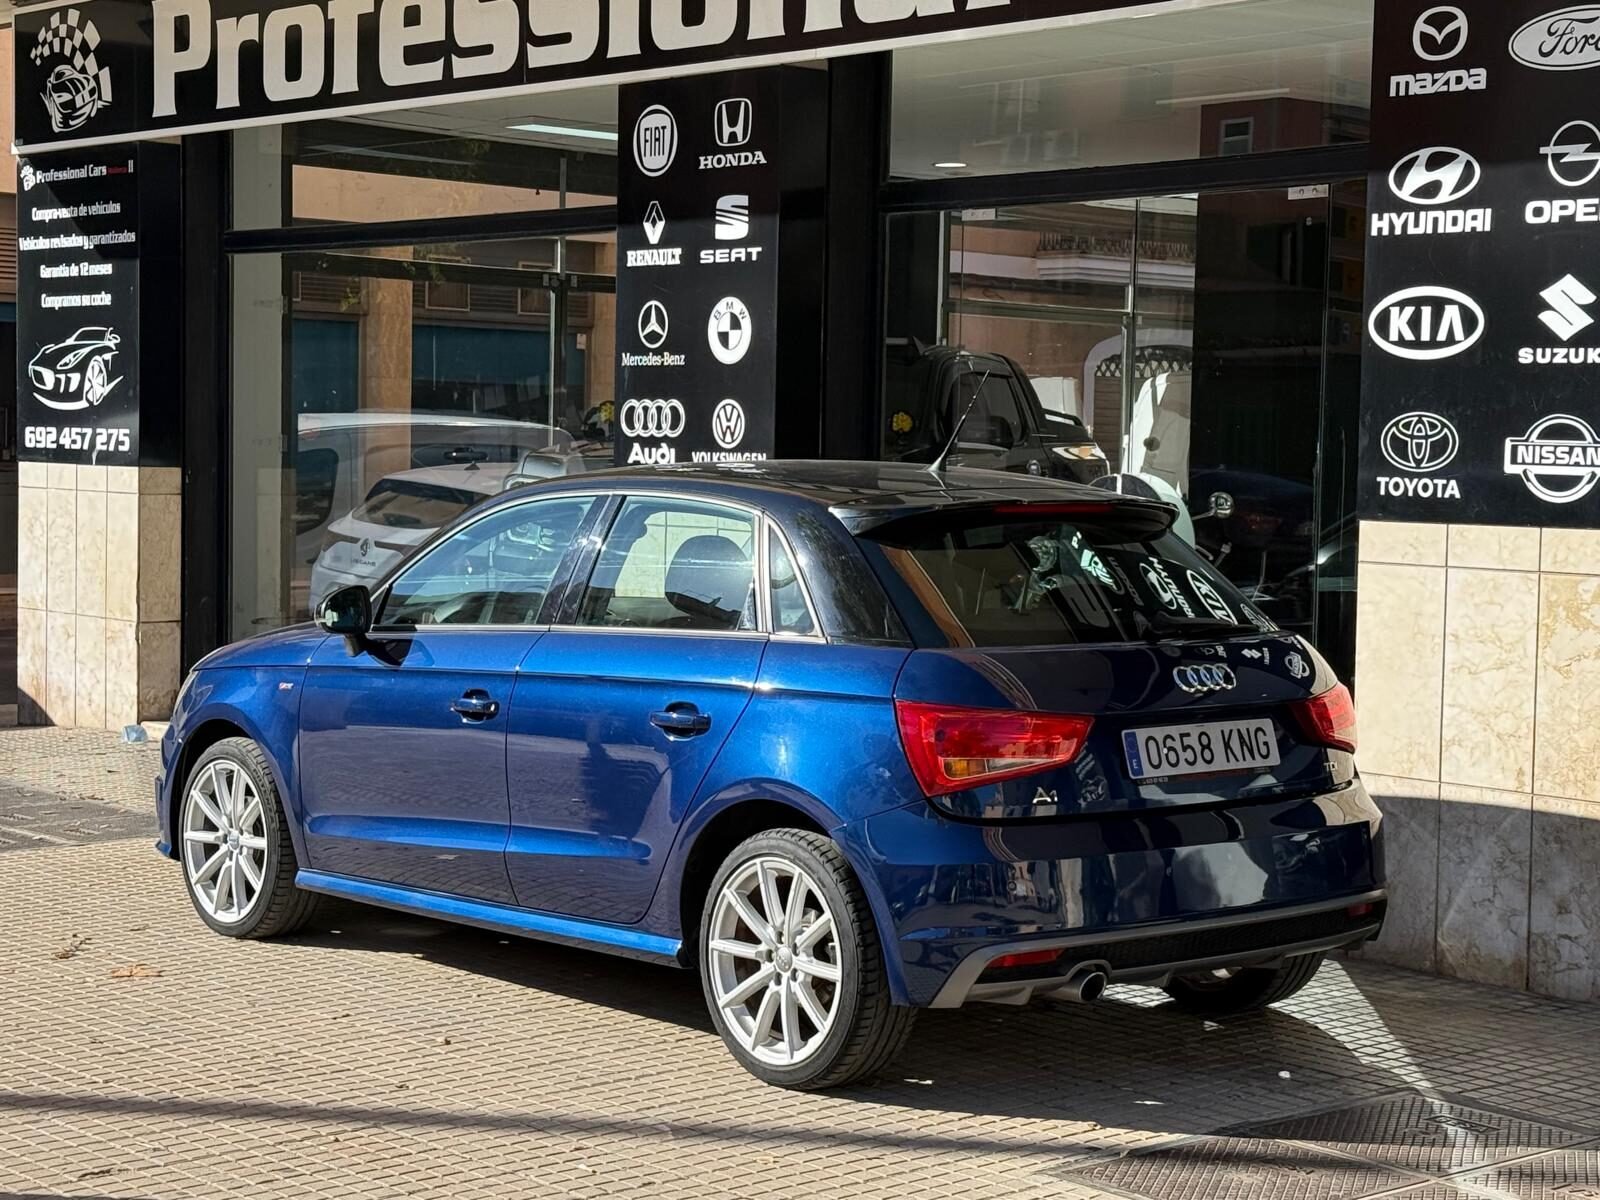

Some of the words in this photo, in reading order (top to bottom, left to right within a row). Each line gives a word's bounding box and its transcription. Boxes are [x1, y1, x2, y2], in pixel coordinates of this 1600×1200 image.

[152, 0, 1010, 118] Profess
[1389, 67, 1487, 97] mazda
[643, 125, 667, 158] FIAT
[698, 151, 767, 169] HONDA
[36, 165, 87, 184] Professional
[88, 164, 107, 177] Cars
[78, 202, 88, 216] de
[1525, 198, 1600, 224] OPE
[1370, 208, 1492, 236] HYUNDAI
[89, 229, 136, 249] garantizados
[626, 248, 682, 267] RENAULT
[700, 247, 762, 264] SEAT
[70, 263, 79, 277] de
[80, 262, 89, 276] 12
[89, 263, 113, 276] meses
[91, 291, 112, 306] coche
[1389, 305, 1464, 341] KIA
[621, 352, 685, 366] Mercedes-Benz
[1518, 347, 1600, 364] SUZUK
[24, 426, 58, 449] 692
[59, 427, 93, 450] 457
[96, 428, 130, 452] 275
[627, 443, 676, 464] Audi
[692, 452, 767, 463] VOLKSWAGEN
[1517, 445, 1600, 465] NISSAN
[1376, 477, 1461, 499] TOYOTA
[1145, 731, 1215, 770] 0658
[1221, 726, 1271, 764] KNG
[1032, 786, 1058, 804] A1
